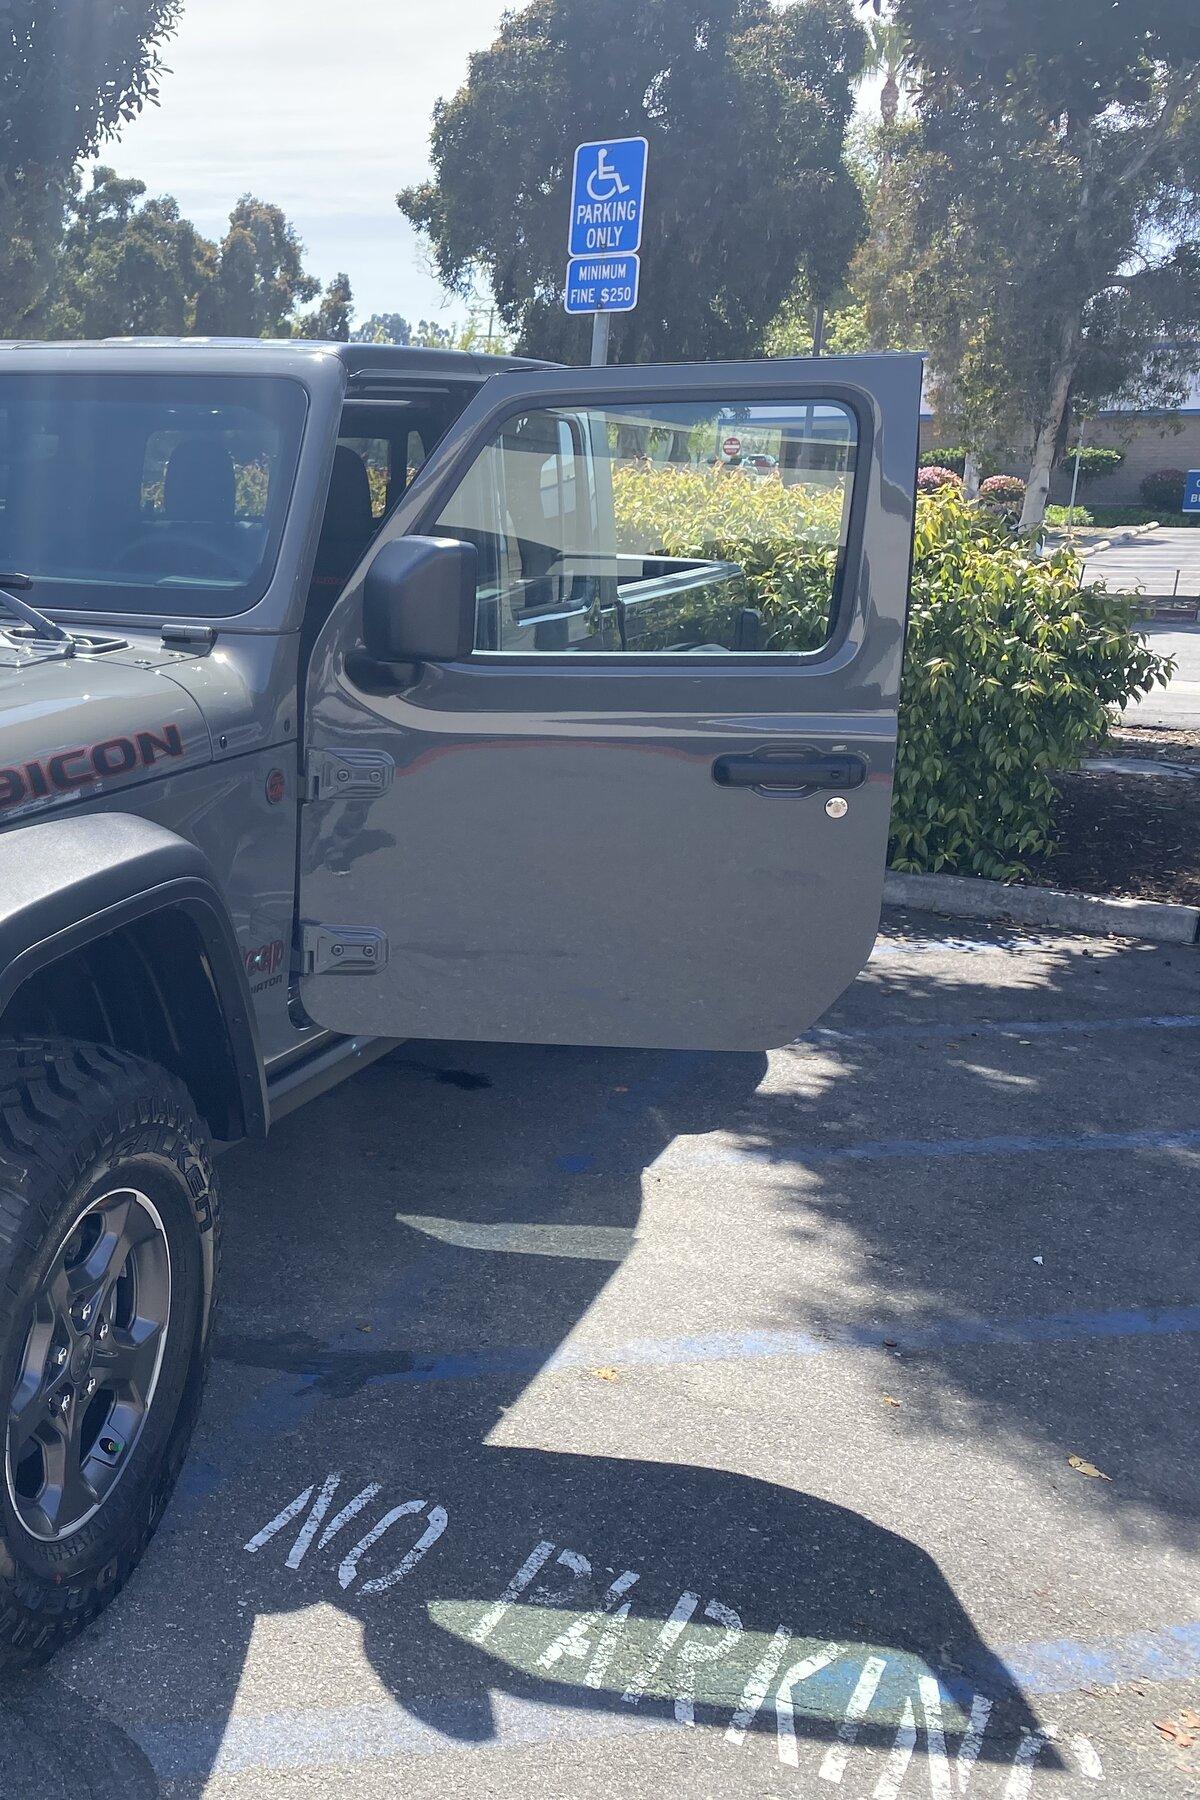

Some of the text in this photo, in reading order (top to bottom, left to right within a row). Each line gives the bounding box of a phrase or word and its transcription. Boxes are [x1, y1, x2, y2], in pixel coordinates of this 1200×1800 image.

[577, 200, 636, 225] PARKING
[586, 226, 623, 248] ONLY
[578, 264, 626, 281] MINIMUM
[570, 286, 631, 304] FINE $250
[244, 1471, 448, 1595] NO
